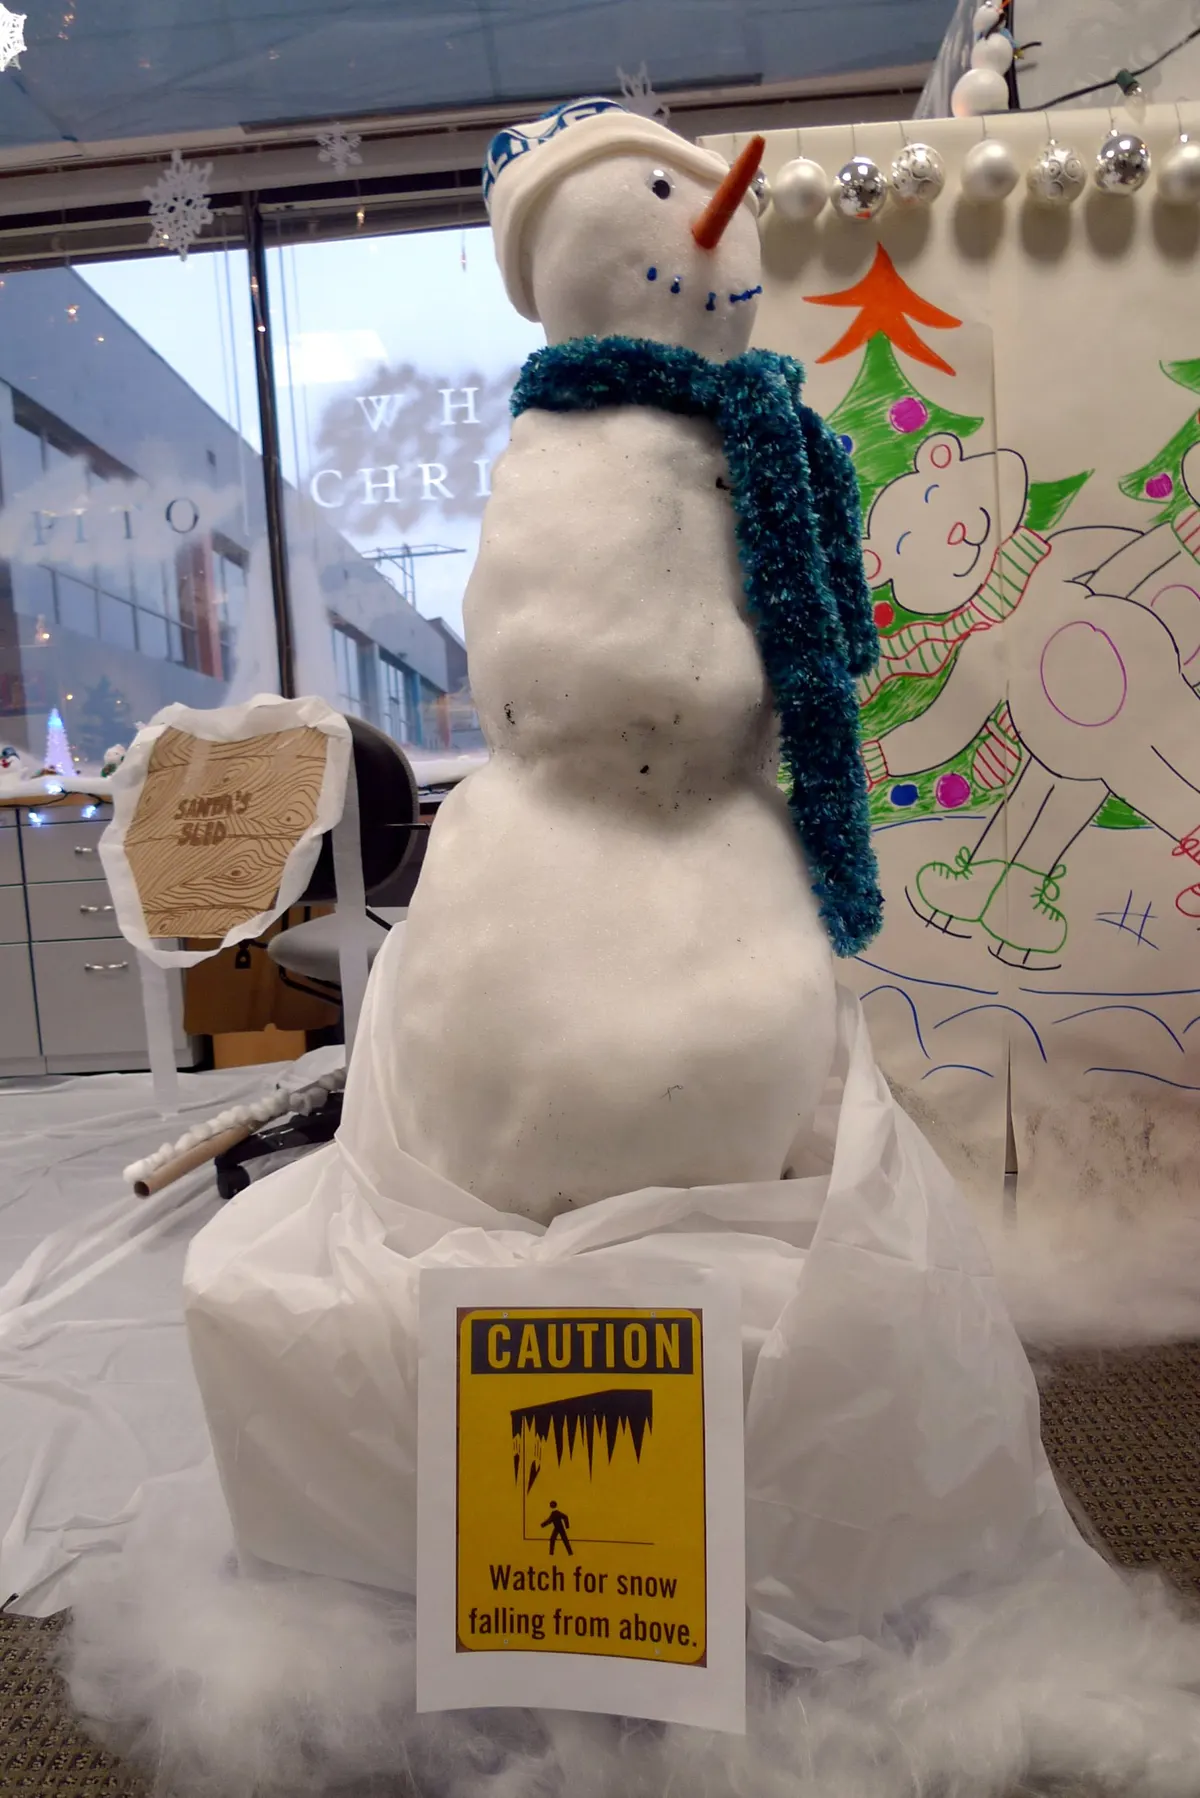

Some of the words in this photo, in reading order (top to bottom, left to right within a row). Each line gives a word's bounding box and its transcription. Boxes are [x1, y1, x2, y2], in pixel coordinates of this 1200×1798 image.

[487, 1323, 681, 1369] CAUTION
[489, 1564, 565, 1591] Watch
[573, 1566, 608, 1594] for
[617, 1574, 677, 1599] snow
[469, 1607, 545, 1640] falling
[553, 1608, 609, 1638] from
[619, 1613, 697, 1648] above.
